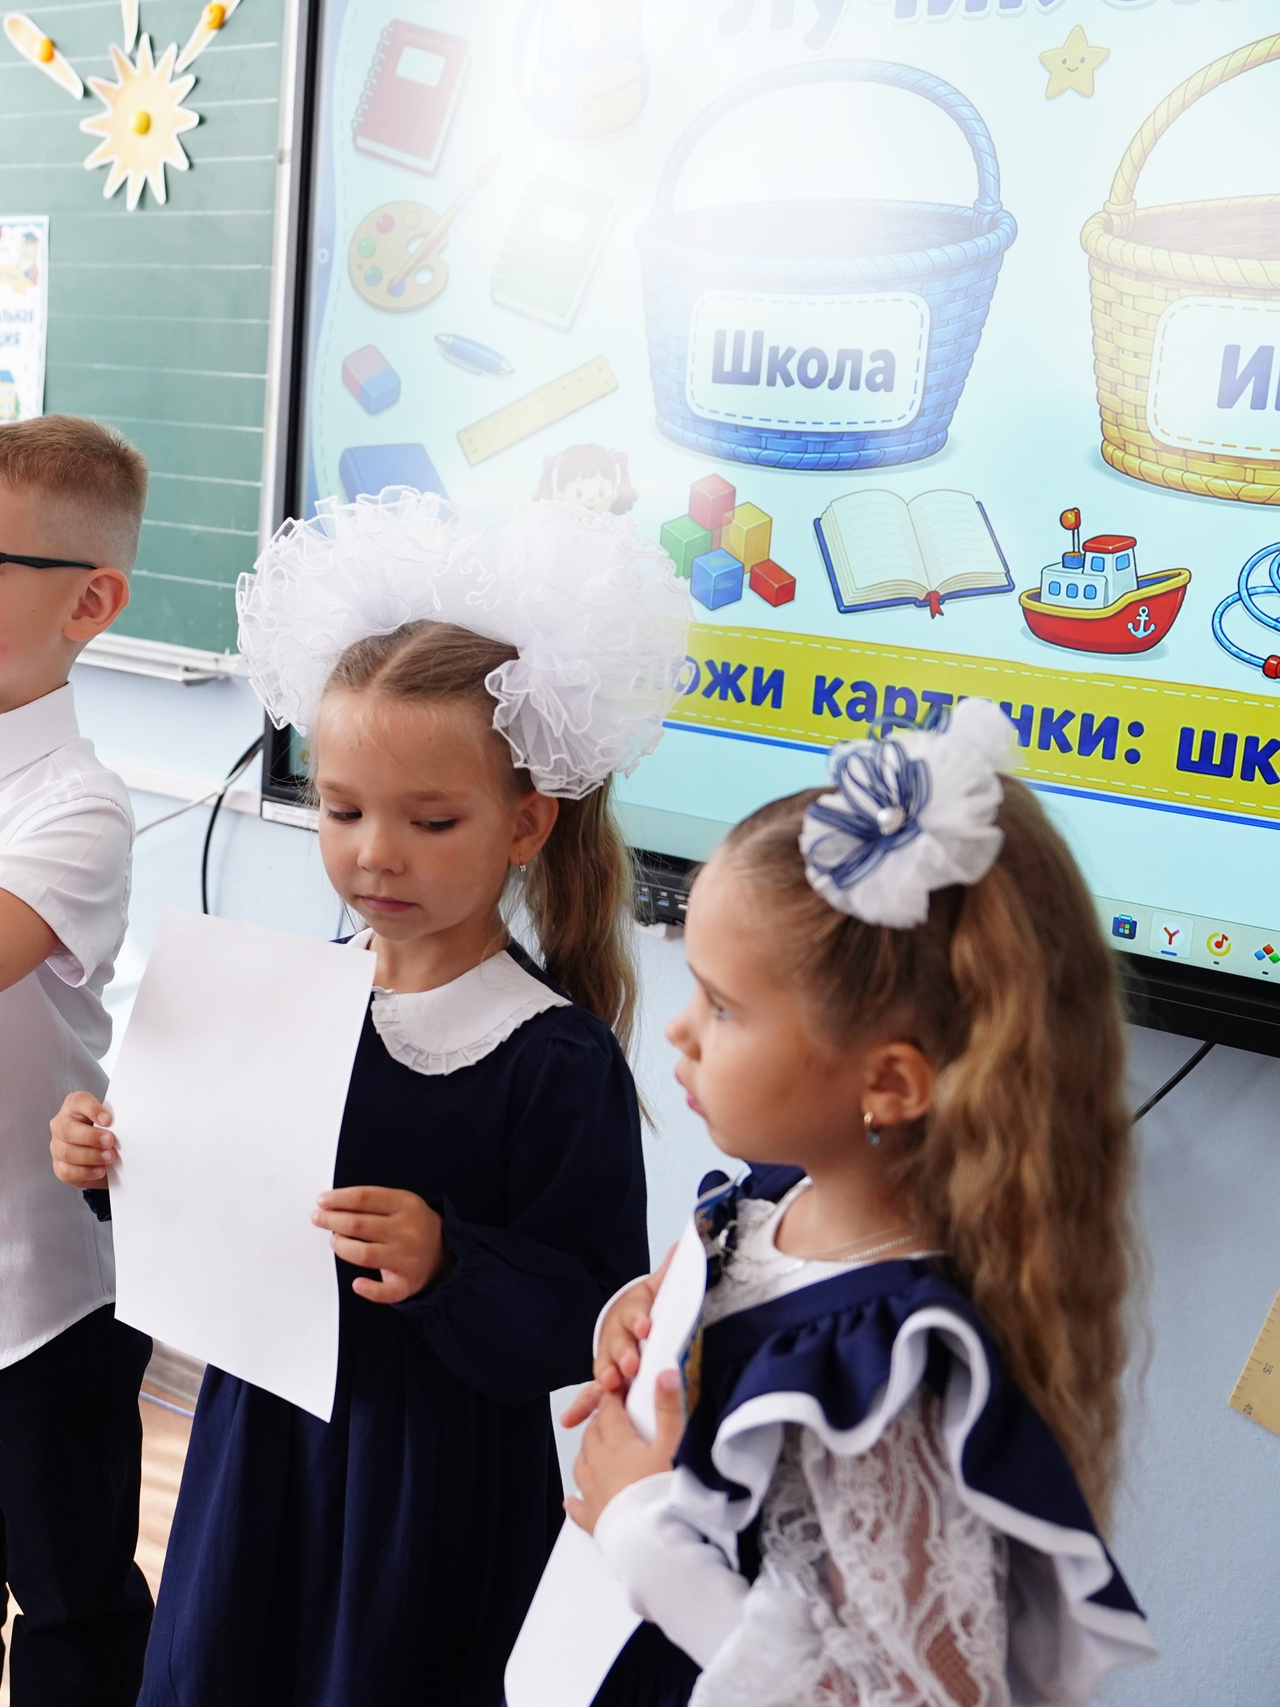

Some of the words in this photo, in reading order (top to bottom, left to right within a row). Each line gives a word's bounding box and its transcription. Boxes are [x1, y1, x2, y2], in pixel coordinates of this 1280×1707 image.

[711, 329, 896, 392] Школа
[1217, 344, 1280, 411] И
[812, 675, 1145, 764] картнки:
